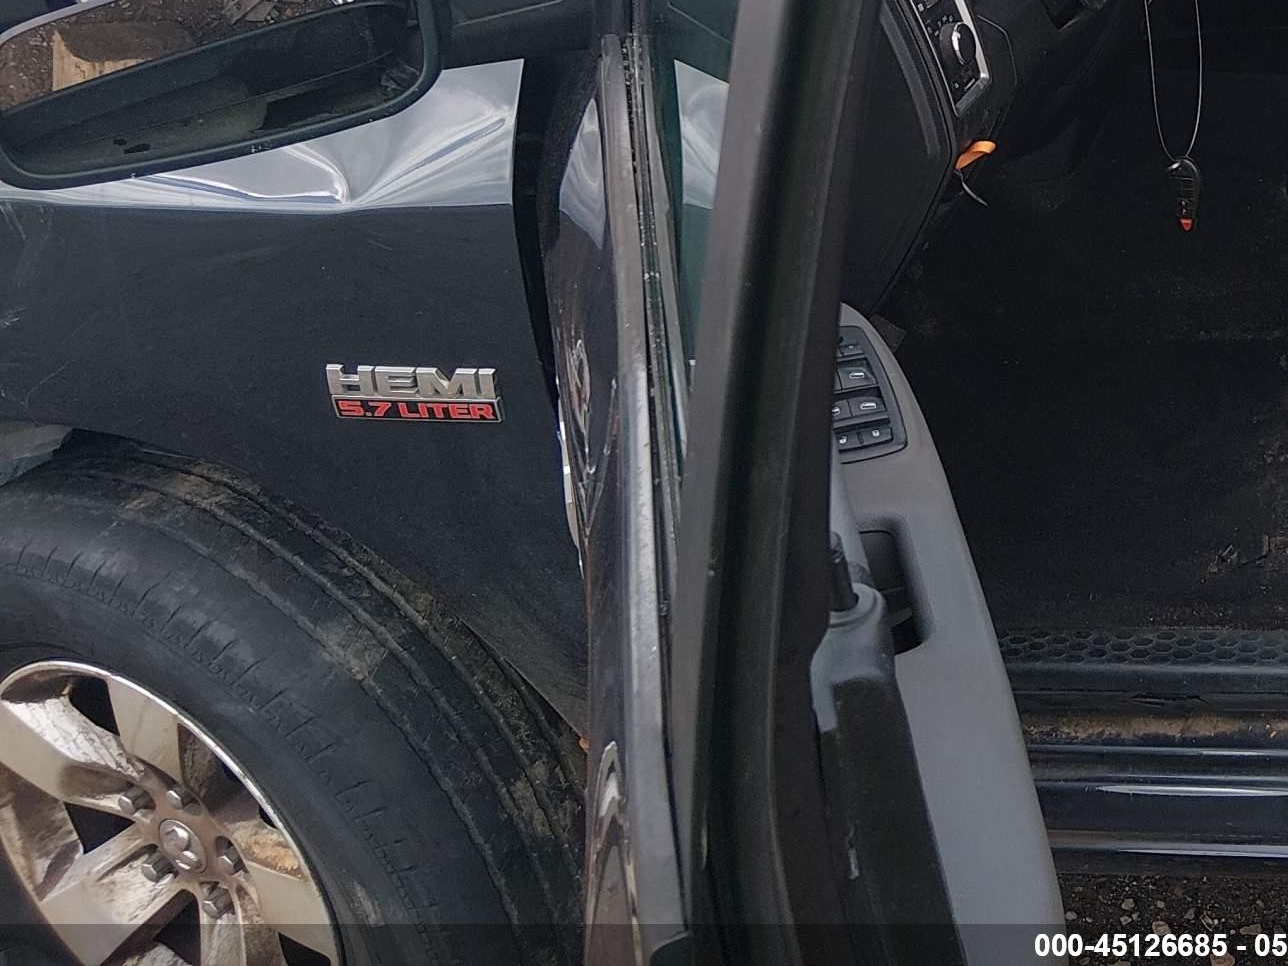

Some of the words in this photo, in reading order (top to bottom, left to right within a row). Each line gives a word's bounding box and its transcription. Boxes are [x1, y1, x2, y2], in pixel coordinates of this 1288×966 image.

[326, 363, 497, 400] HEMI
[337, 400, 392, 418] 5.7
[398, 402, 496, 420] LITER
